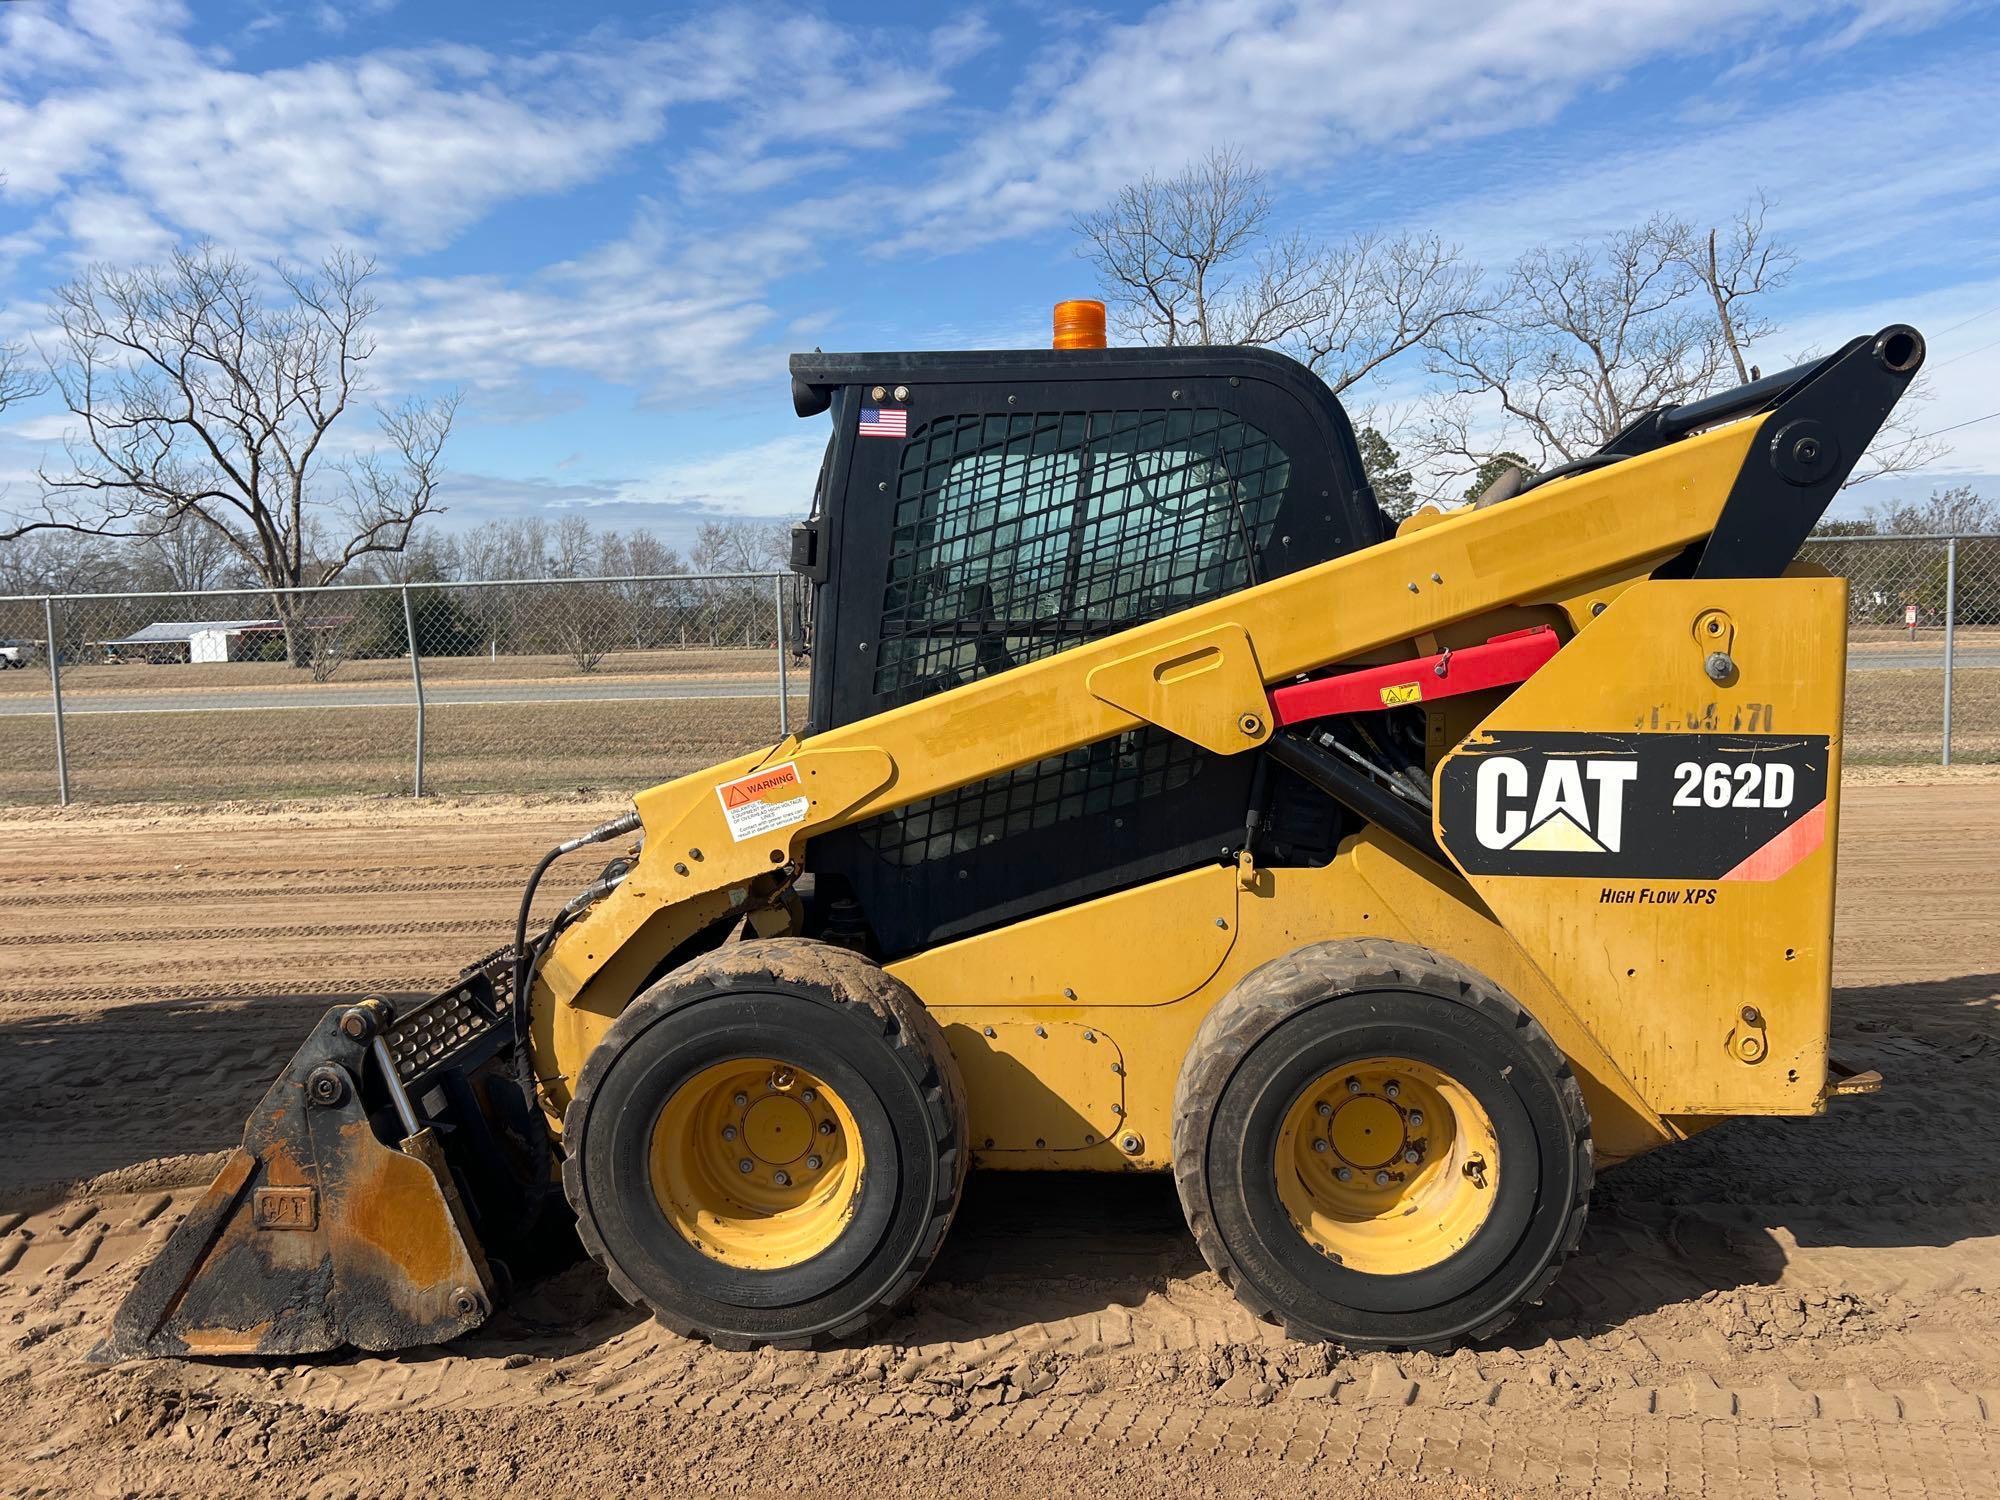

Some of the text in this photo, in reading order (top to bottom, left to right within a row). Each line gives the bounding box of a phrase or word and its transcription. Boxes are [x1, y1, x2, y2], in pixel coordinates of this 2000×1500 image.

[747, 773, 794, 794] WARNING
[1673, 760, 1796, 809] 262D
[1476, 756, 1639, 854] CAT
[1683, 889, 1717, 904] XPS
